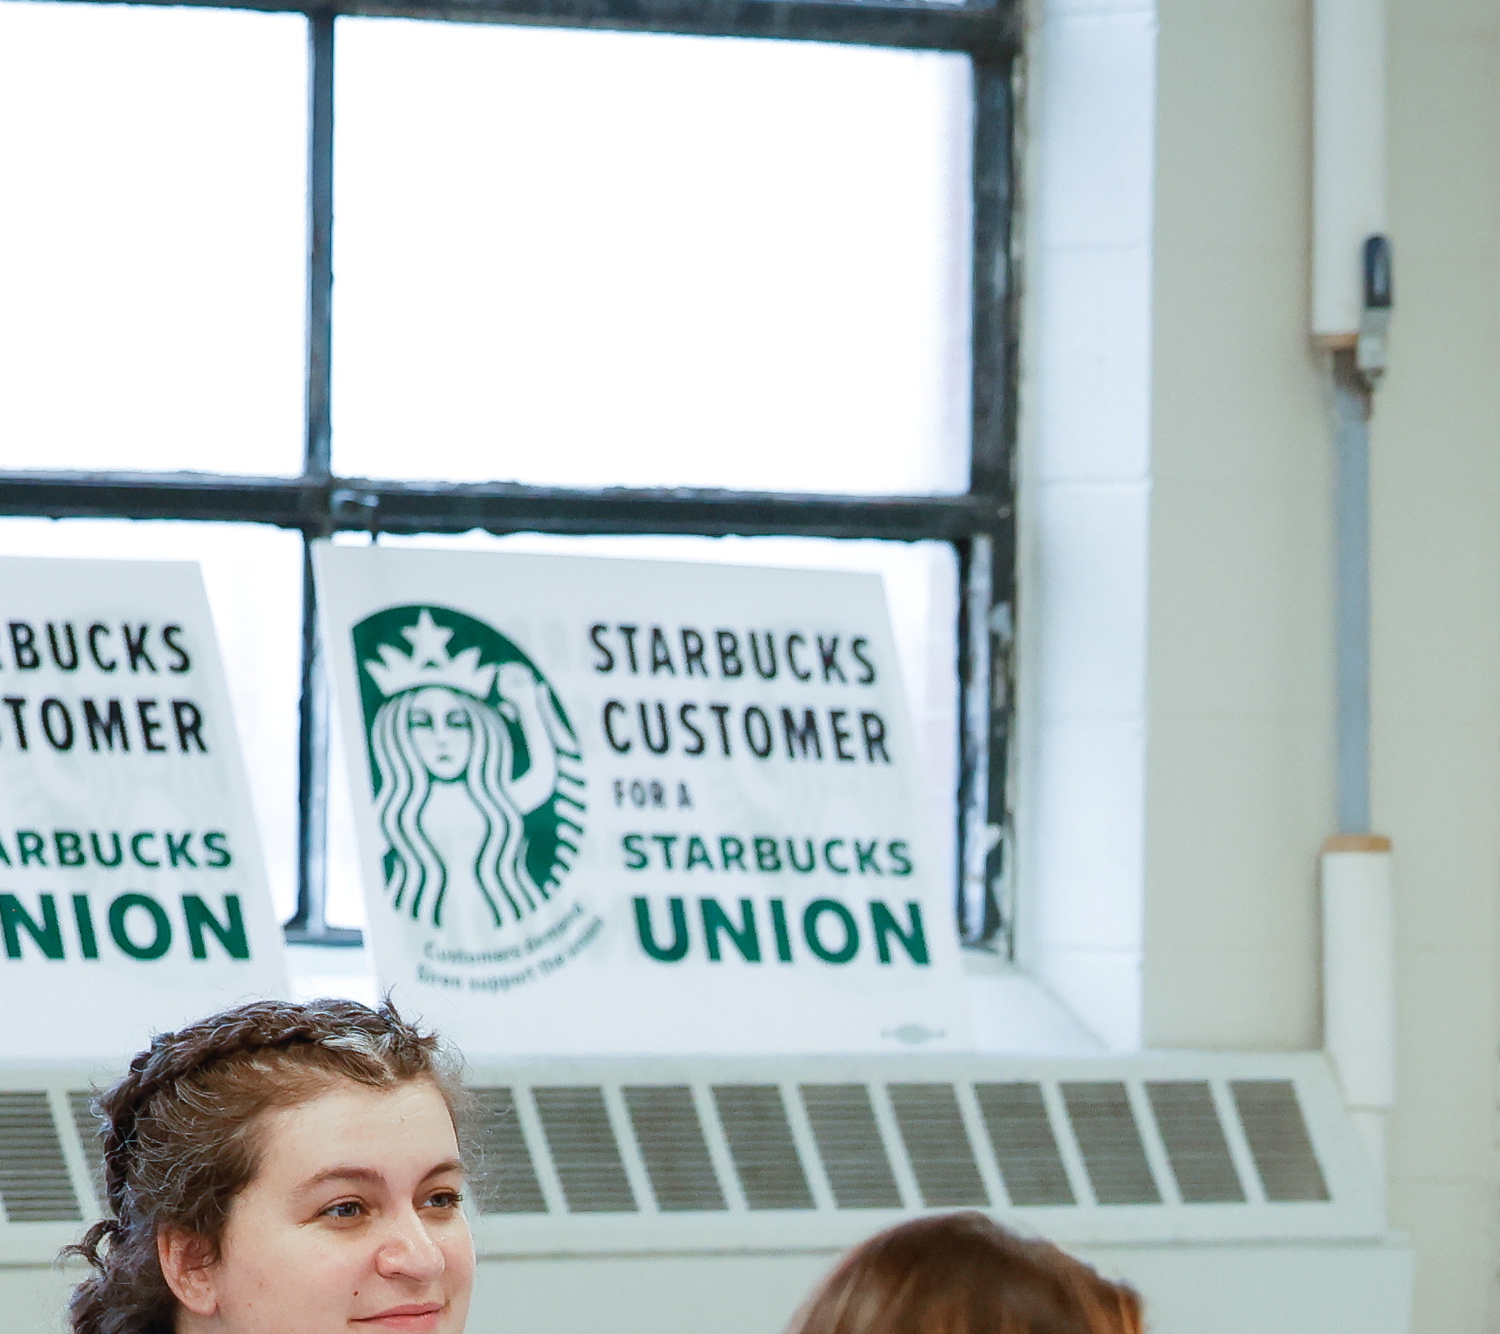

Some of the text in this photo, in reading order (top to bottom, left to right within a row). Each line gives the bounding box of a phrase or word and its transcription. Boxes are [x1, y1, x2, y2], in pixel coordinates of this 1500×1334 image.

[591, 624, 876, 686] STARBUCKS
[603, 700, 892, 764] CUSTOMER
[613, 780, 693, 808] FOR A
[623, 833, 913, 877] STARBUCKS
[633, 897, 931, 966] UNION
